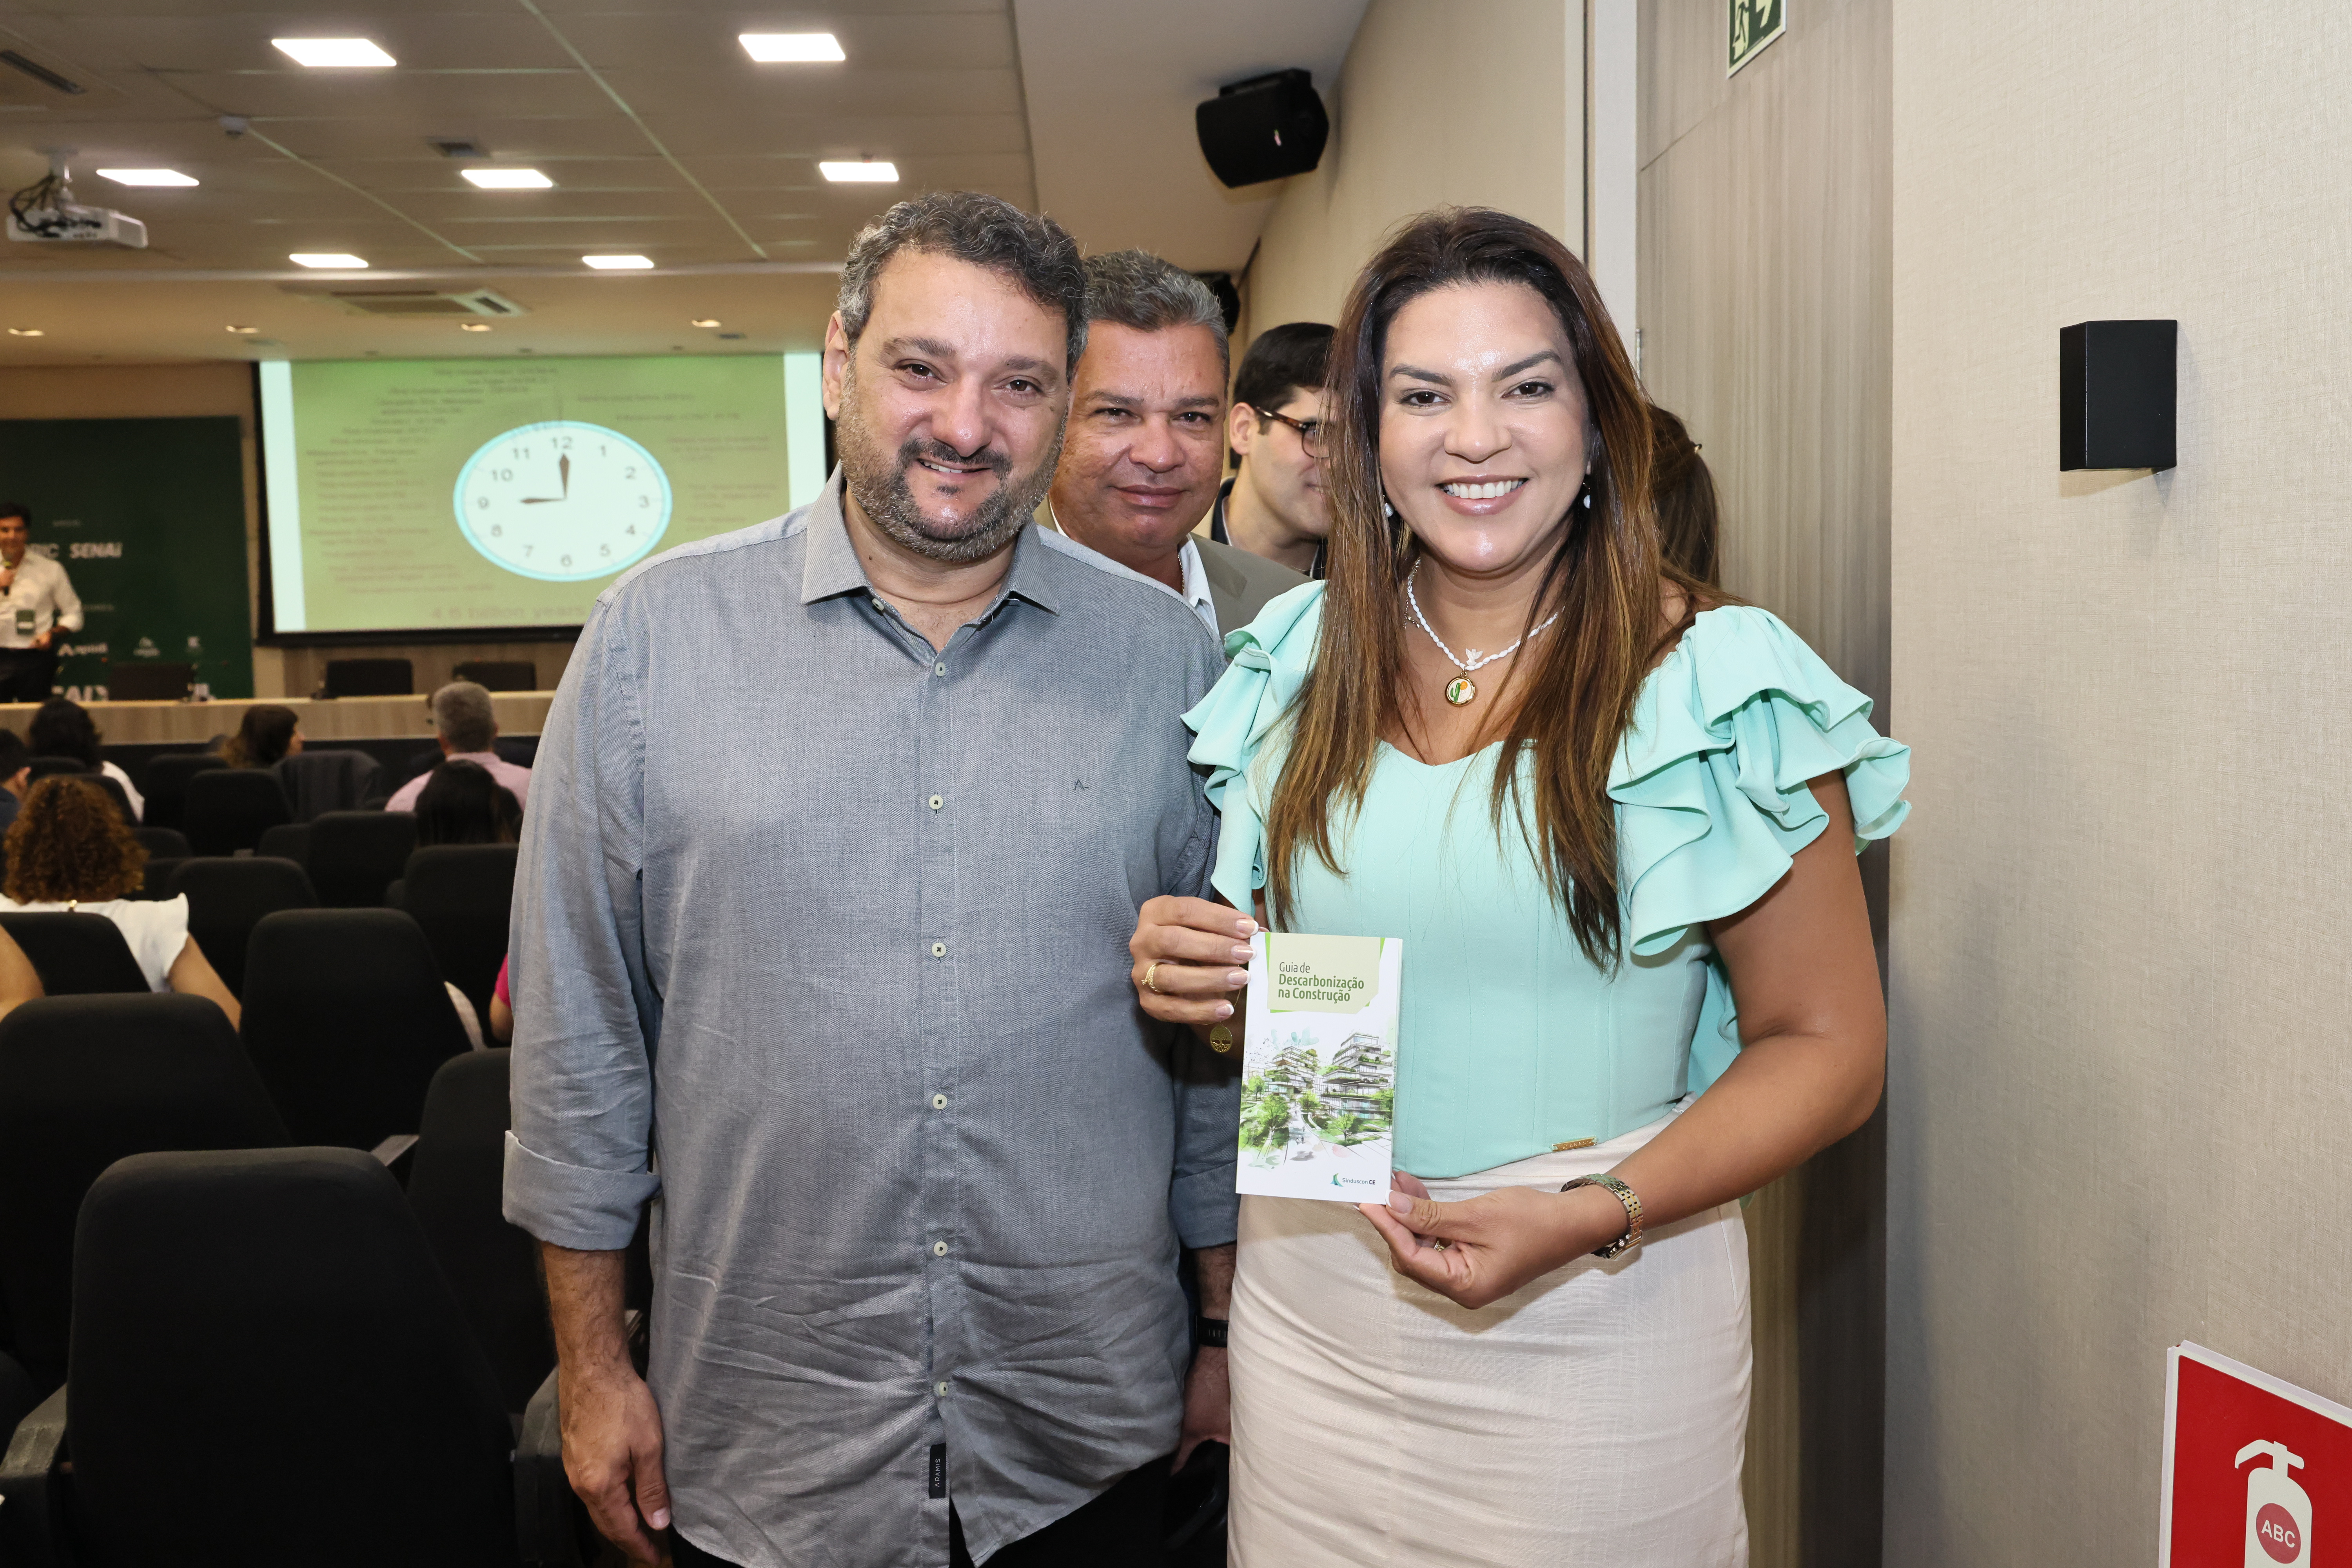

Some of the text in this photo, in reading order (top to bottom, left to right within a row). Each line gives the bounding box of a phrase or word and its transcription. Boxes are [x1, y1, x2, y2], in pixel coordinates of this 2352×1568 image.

[552, 436, 573, 450] 12
[513, 447, 530, 459] 11
[600, 445, 606, 457] 1
[492, 468, 513, 481] 10
[625, 466, 636, 479] 2
[477, 496, 489, 510] 9
[639, 495, 650, 508] 3
[491, 524, 502, 537] 8
[625, 524, 635, 535] 4
[69, 542, 123, 559] SENAI
[523, 544, 534, 557] 7
[599, 543, 610, 557] 5
[561, 554, 572, 567] 6
[1279, 962, 1310, 973] Guia de
[1279, 973, 1364, 991] Descarbonização
[1278, 987, 1350, 1004] na Construção
[2261, 1519, 2295, 1548] ABC
